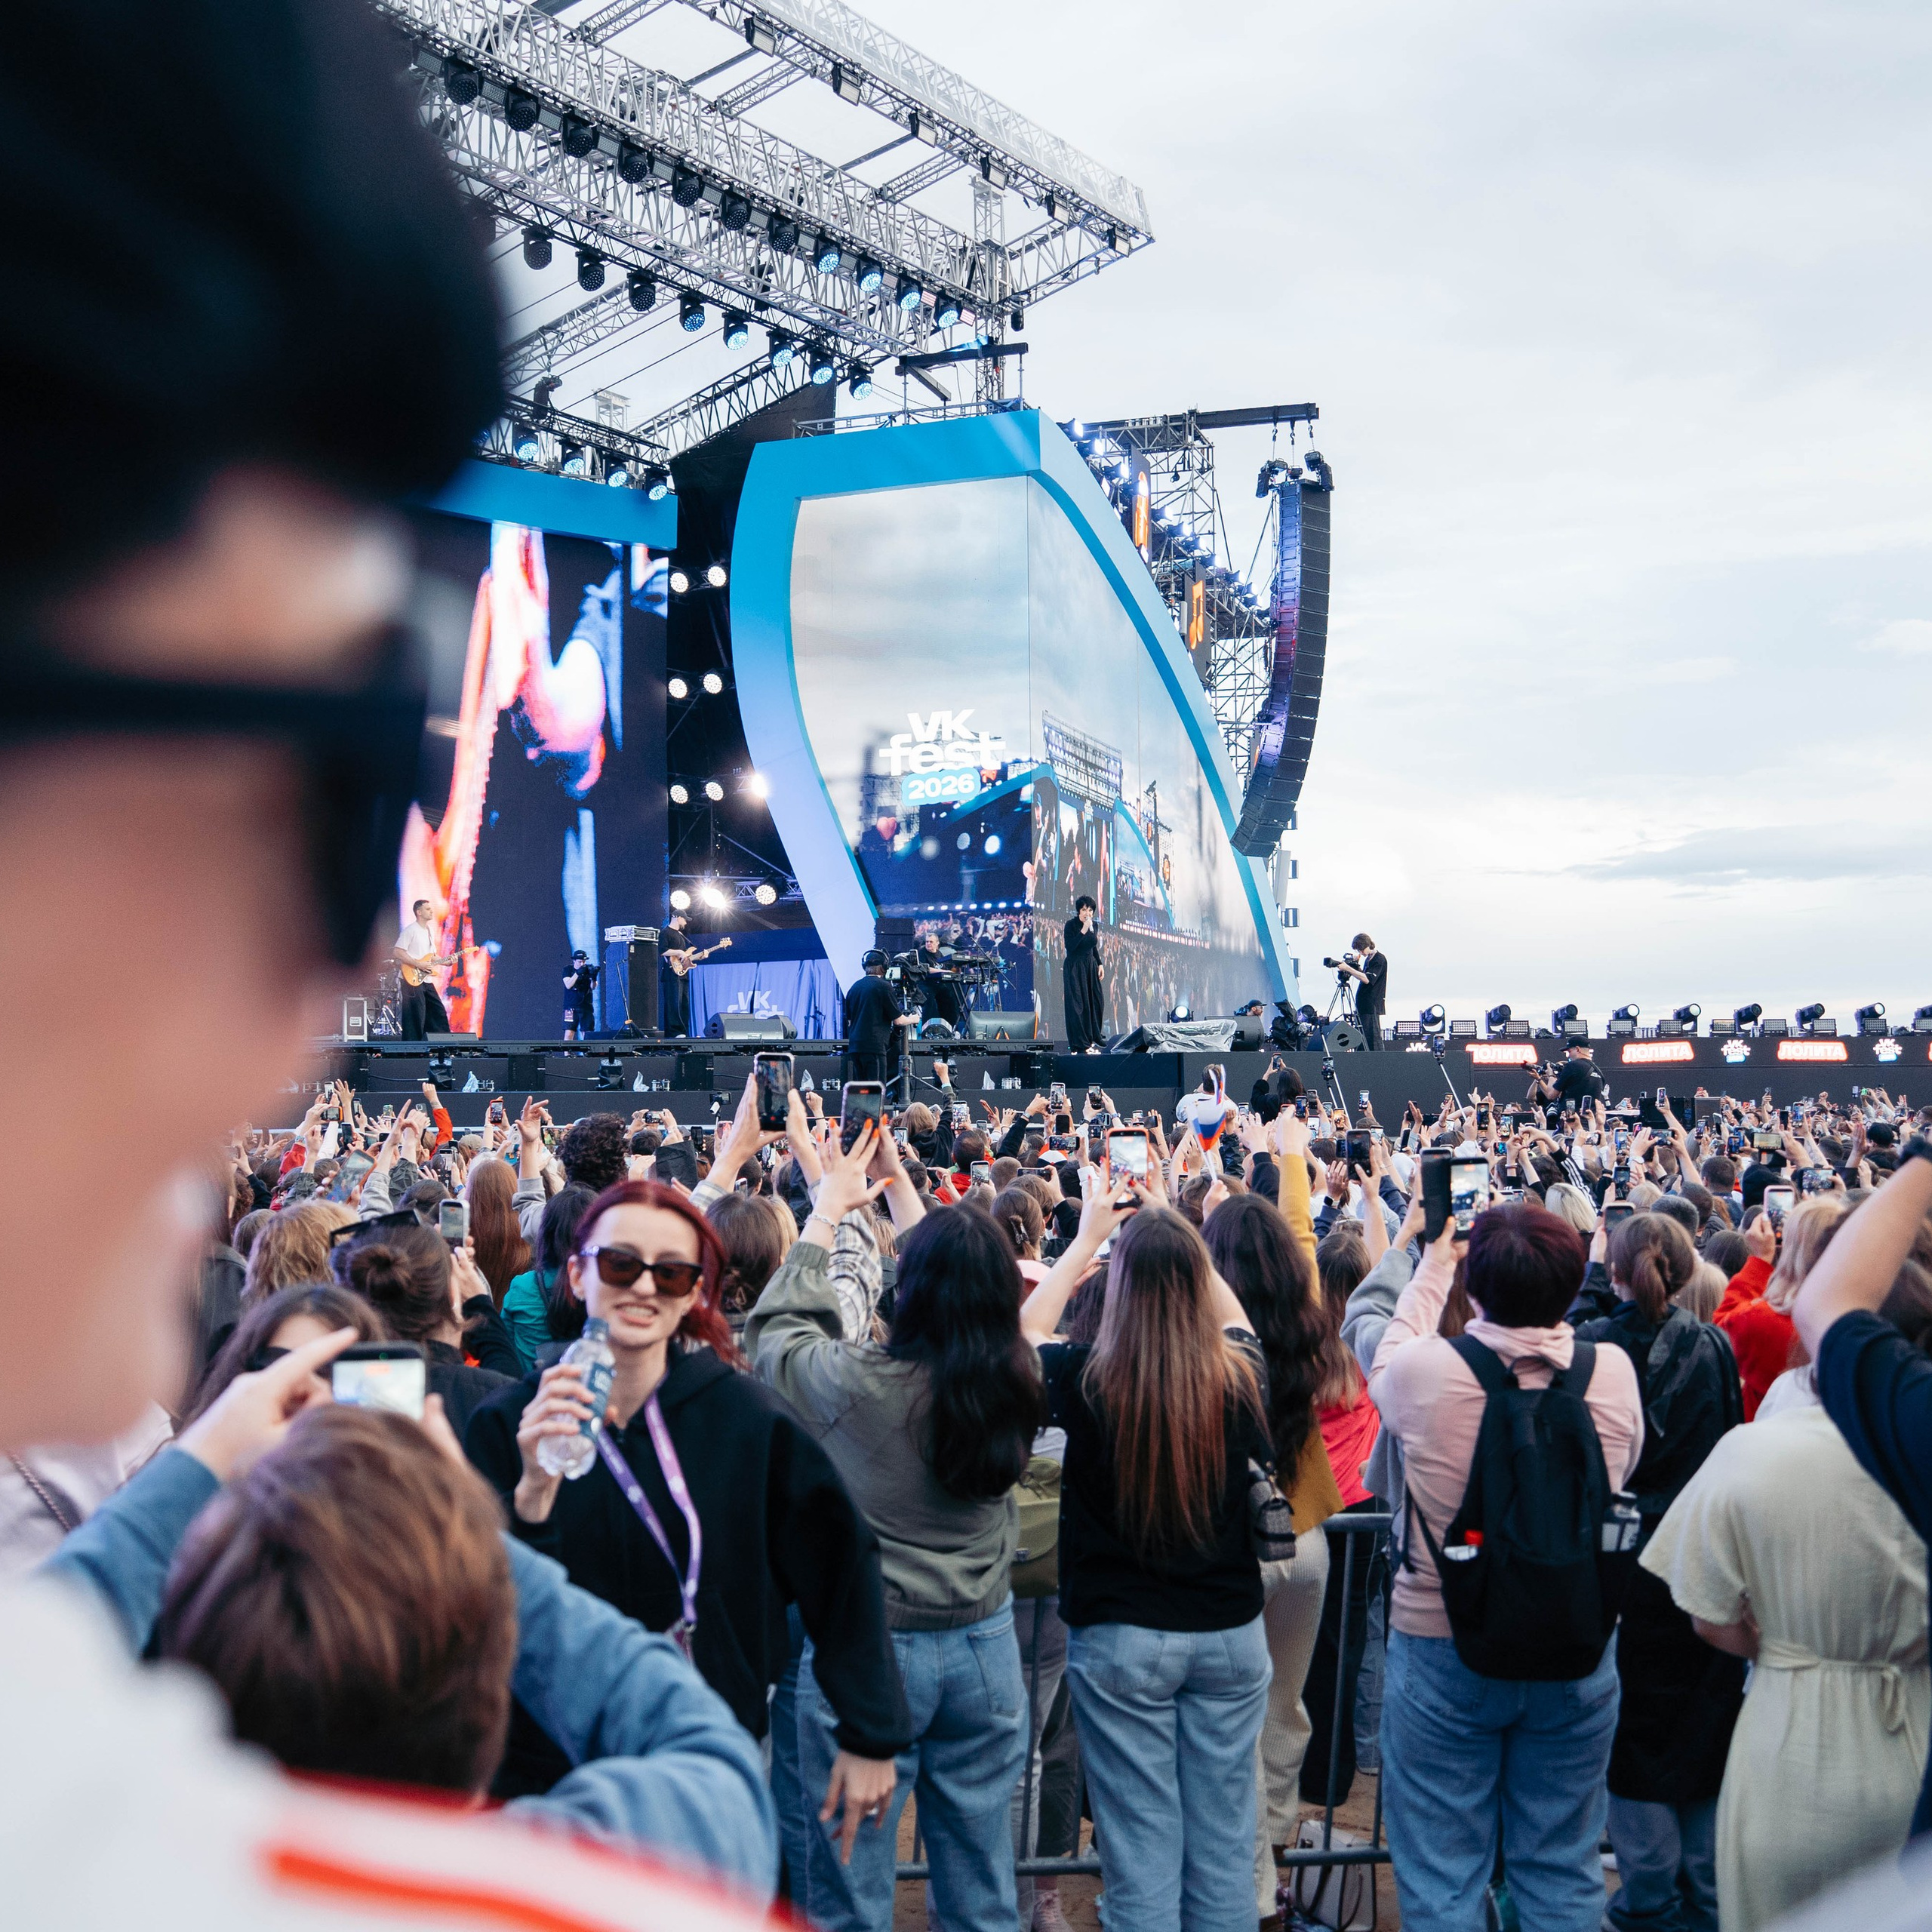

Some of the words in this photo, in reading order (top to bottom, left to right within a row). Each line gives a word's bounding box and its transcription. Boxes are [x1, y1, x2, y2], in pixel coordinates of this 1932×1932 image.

[907, 709, 976, 742] VK
[879, 731, 1006, 777] fest
[908, 774, 975, 800] 2026
[737, 990, 772, 1011] VK
[1410, 1042, 1427, 1052] VK
[1721, 1044, 1751, 1056] fest
[1727, 1040, 1744, 1048] VK
[1878, 1038, 1895, 1048] VK
[1624, 1044, 1691, 1060] ЛОЛИТА
[1779, 1044, 1844, 1058] ЛОЛИТА
